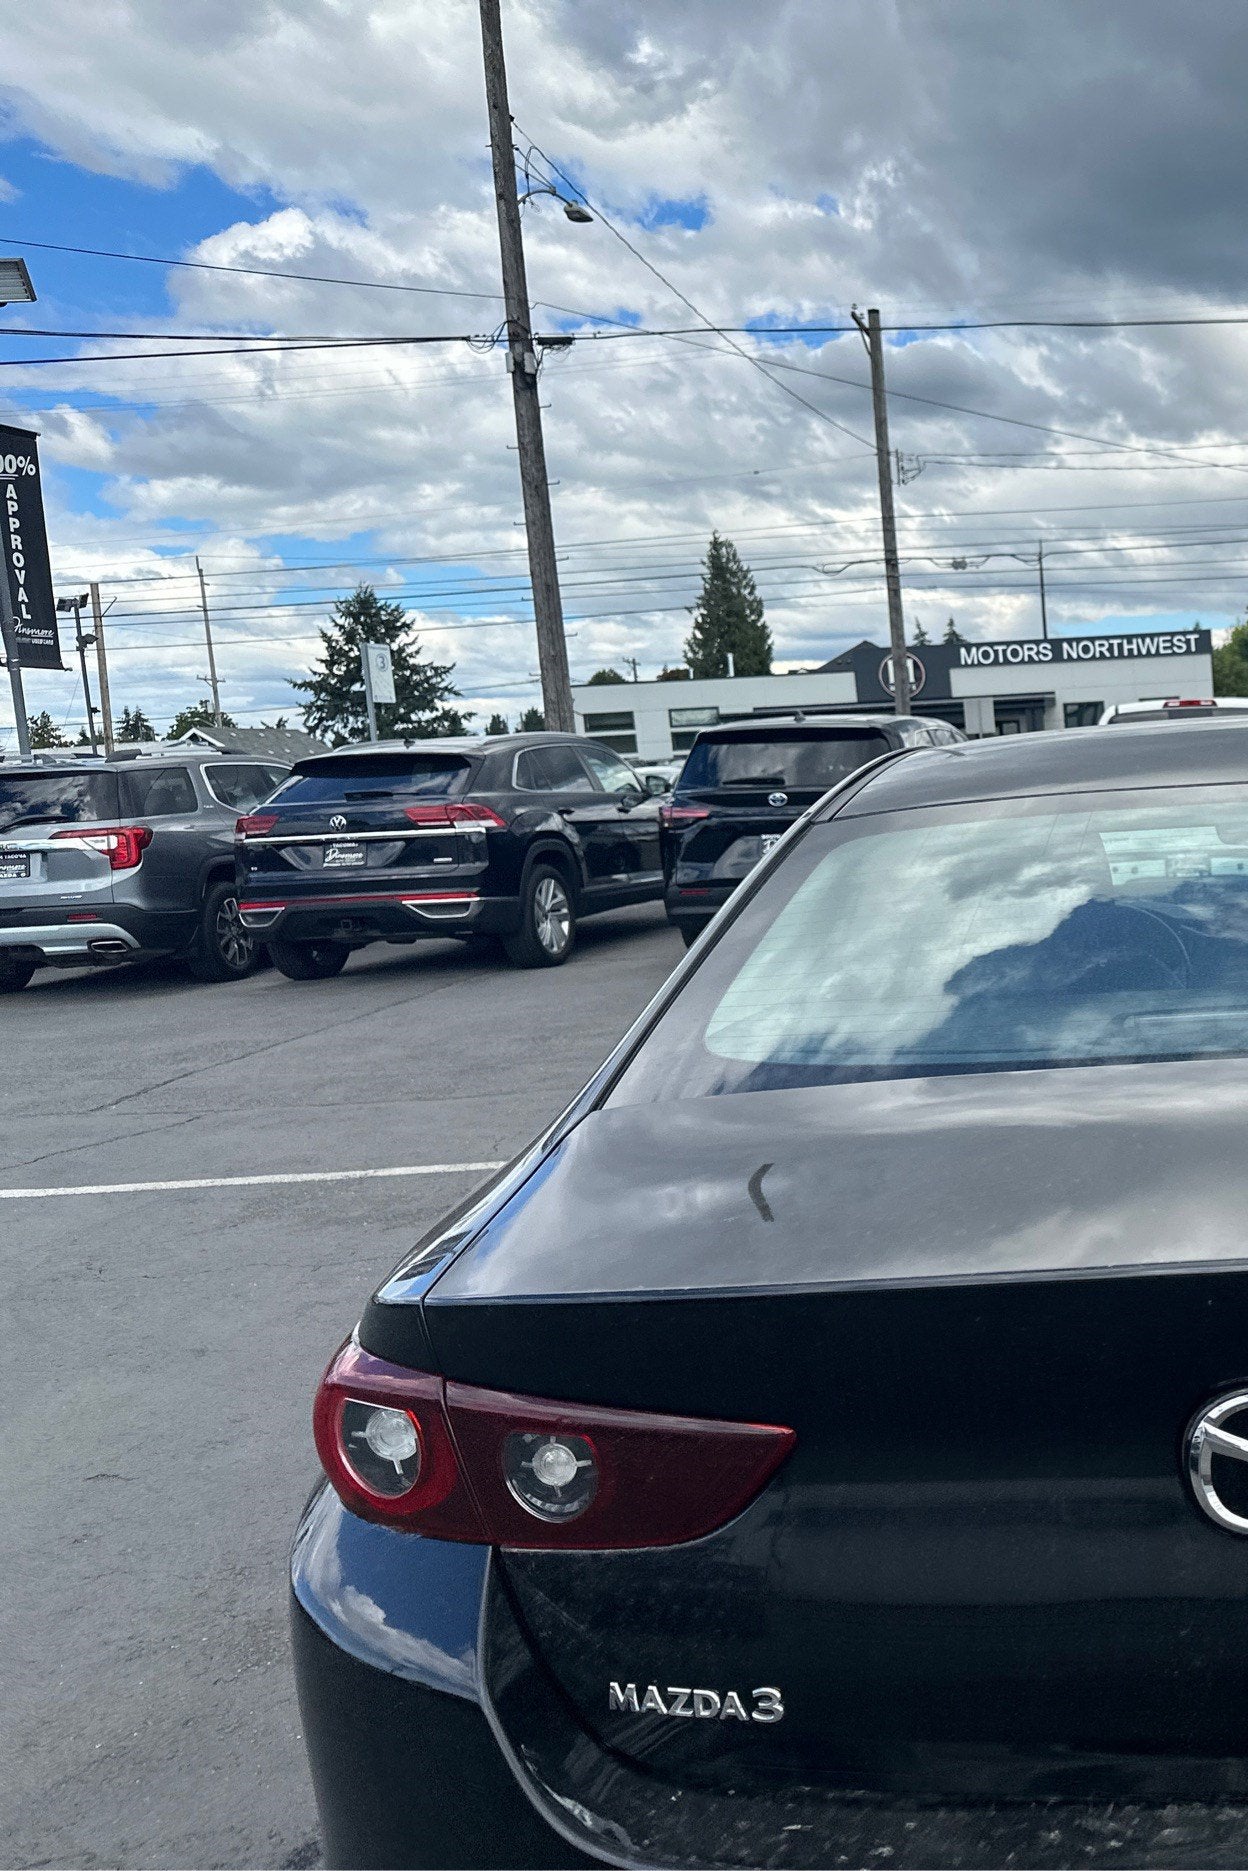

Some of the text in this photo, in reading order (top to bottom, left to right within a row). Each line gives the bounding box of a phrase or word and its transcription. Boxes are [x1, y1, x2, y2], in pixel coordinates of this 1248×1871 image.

[6, 483, 32, 620] APPROVAL
[960, 634, 1200, 666] MOTORS NORTHWEST
[609, 1681, 785, 1724] MAZDA3
